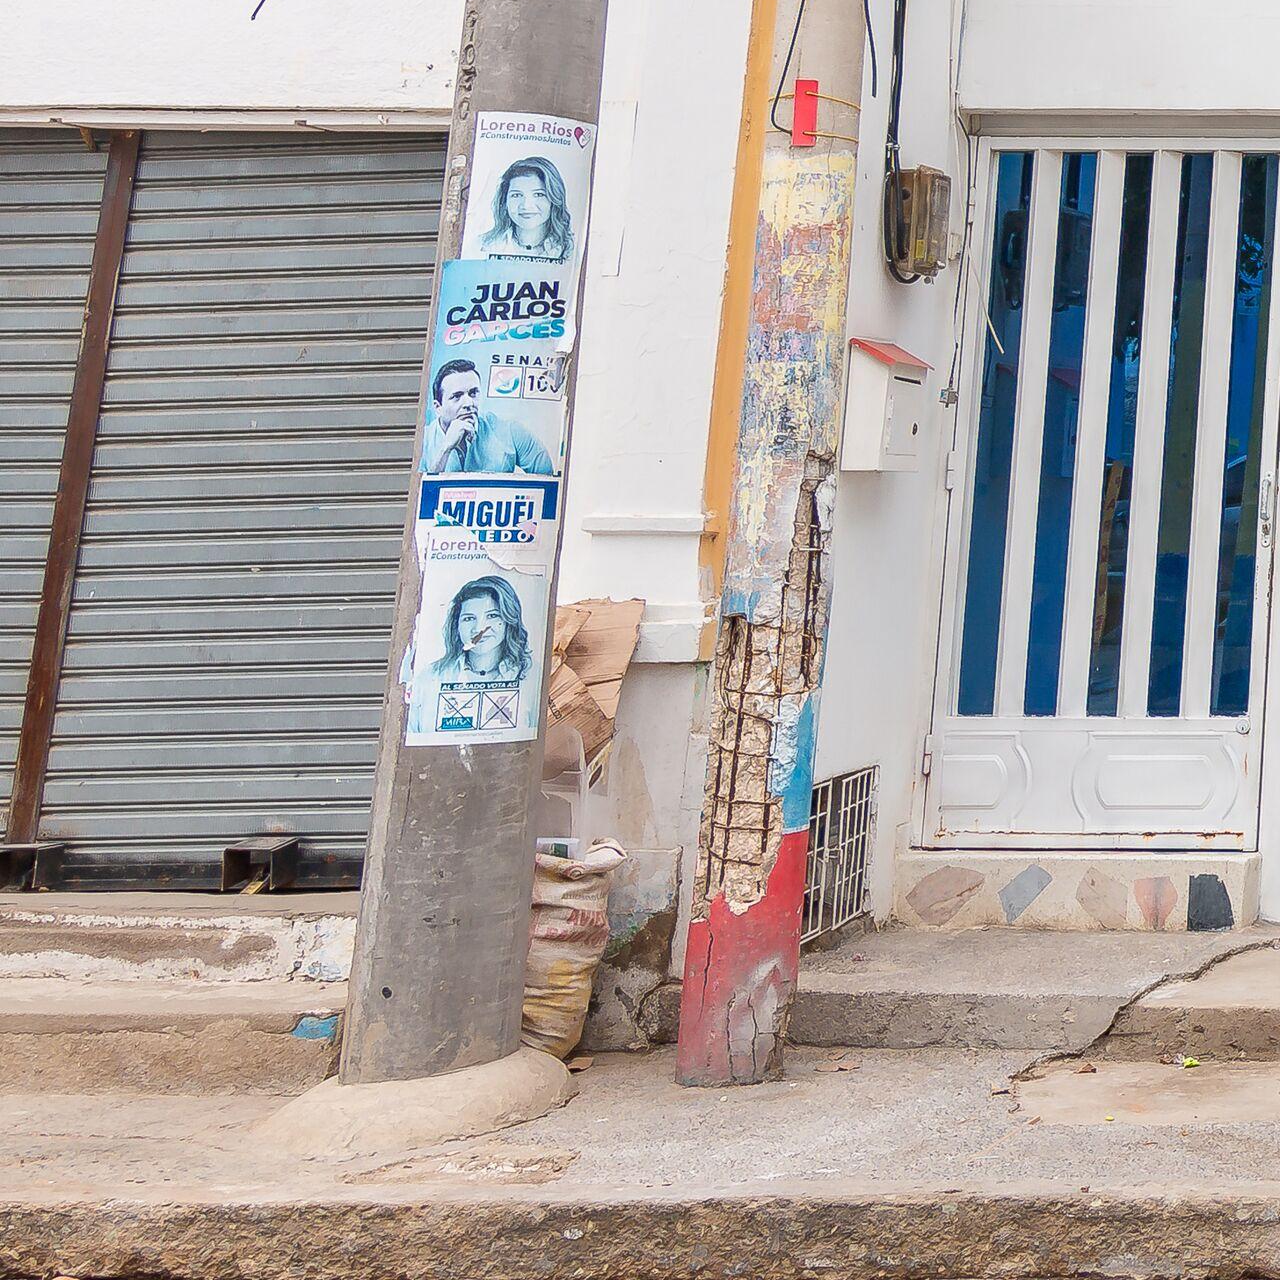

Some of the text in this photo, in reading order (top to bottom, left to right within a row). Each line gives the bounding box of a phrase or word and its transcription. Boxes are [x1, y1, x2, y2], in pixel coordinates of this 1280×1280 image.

[480, 118, 573, 138] Lorena Ríos
[480, 131, 572, 147] #ConstruyamosJuntos
[471, 280, 560, 304] JUAN
[446, 299, 566, 326] CARLOS
[443, 316, 566, 346] GARCÉS
[491, 354, 554, 367] SENA
